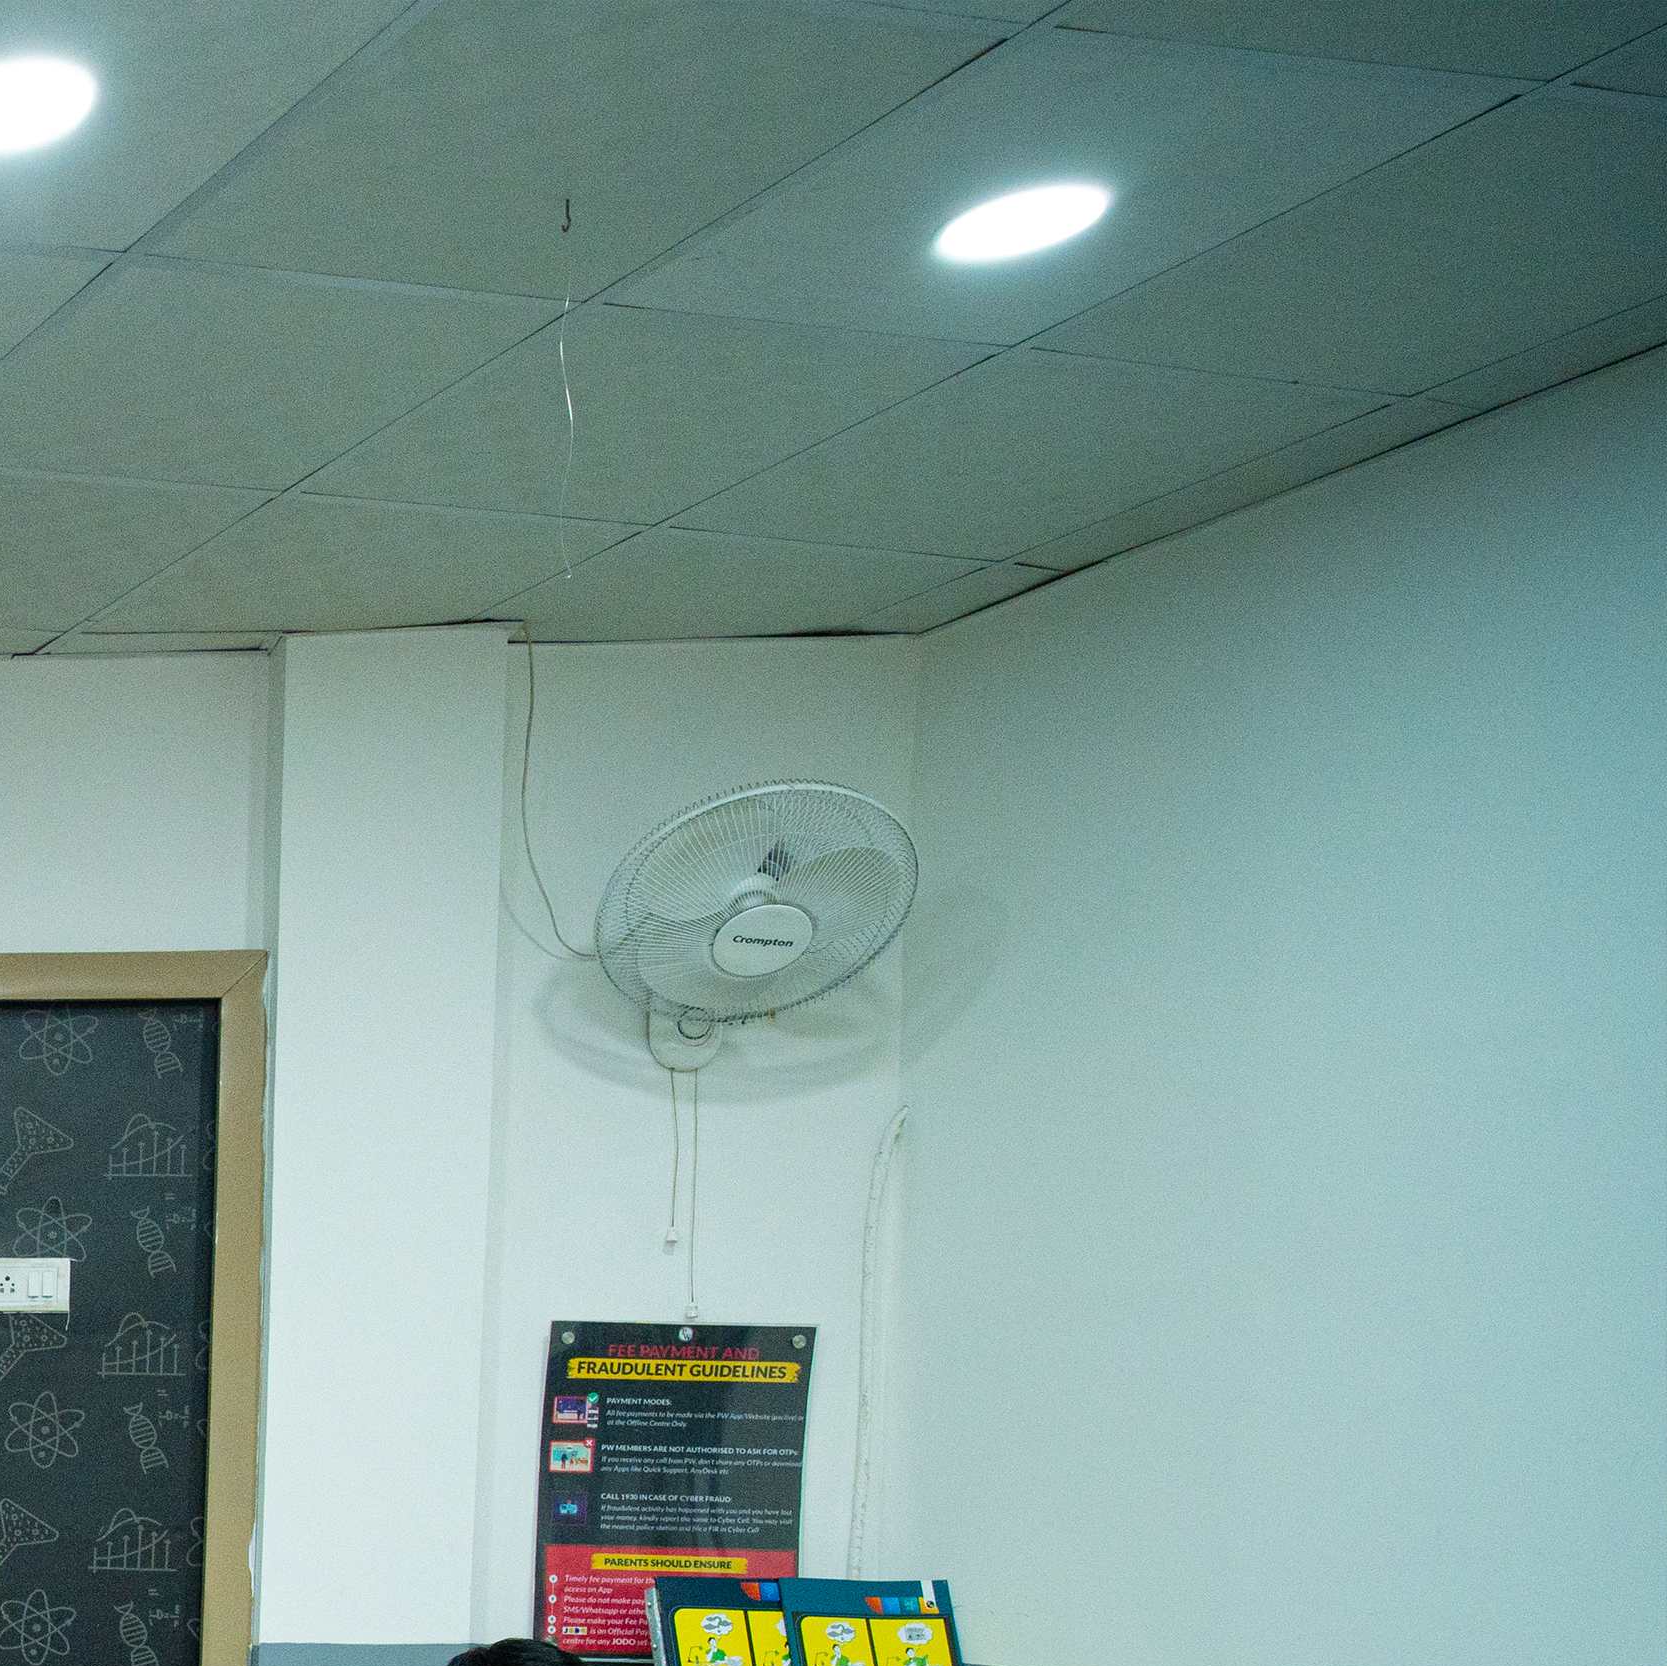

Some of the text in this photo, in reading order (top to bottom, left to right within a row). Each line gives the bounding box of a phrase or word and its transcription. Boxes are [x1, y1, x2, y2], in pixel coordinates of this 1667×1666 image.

[732, 935, 793, 947] Crompton
[609, 1344, 760, 1361] FEE PAYMENT AND
[578, 1361, 786, 1380] FRAUDULENT GUIDELINES
[607, 1397, 641, 1405] PAYMENT
[601, 1493, 619, 1501] CALL
[639, 1494, 647, 1502] IN
[649, 1494, 667, 1502] CASE
[668, 1495, 678, 1503] OF
[680, 1495, 705, 1503] CYBER
[604, 1558, 732, 1569] PARENTS SHOULD ENSURE
